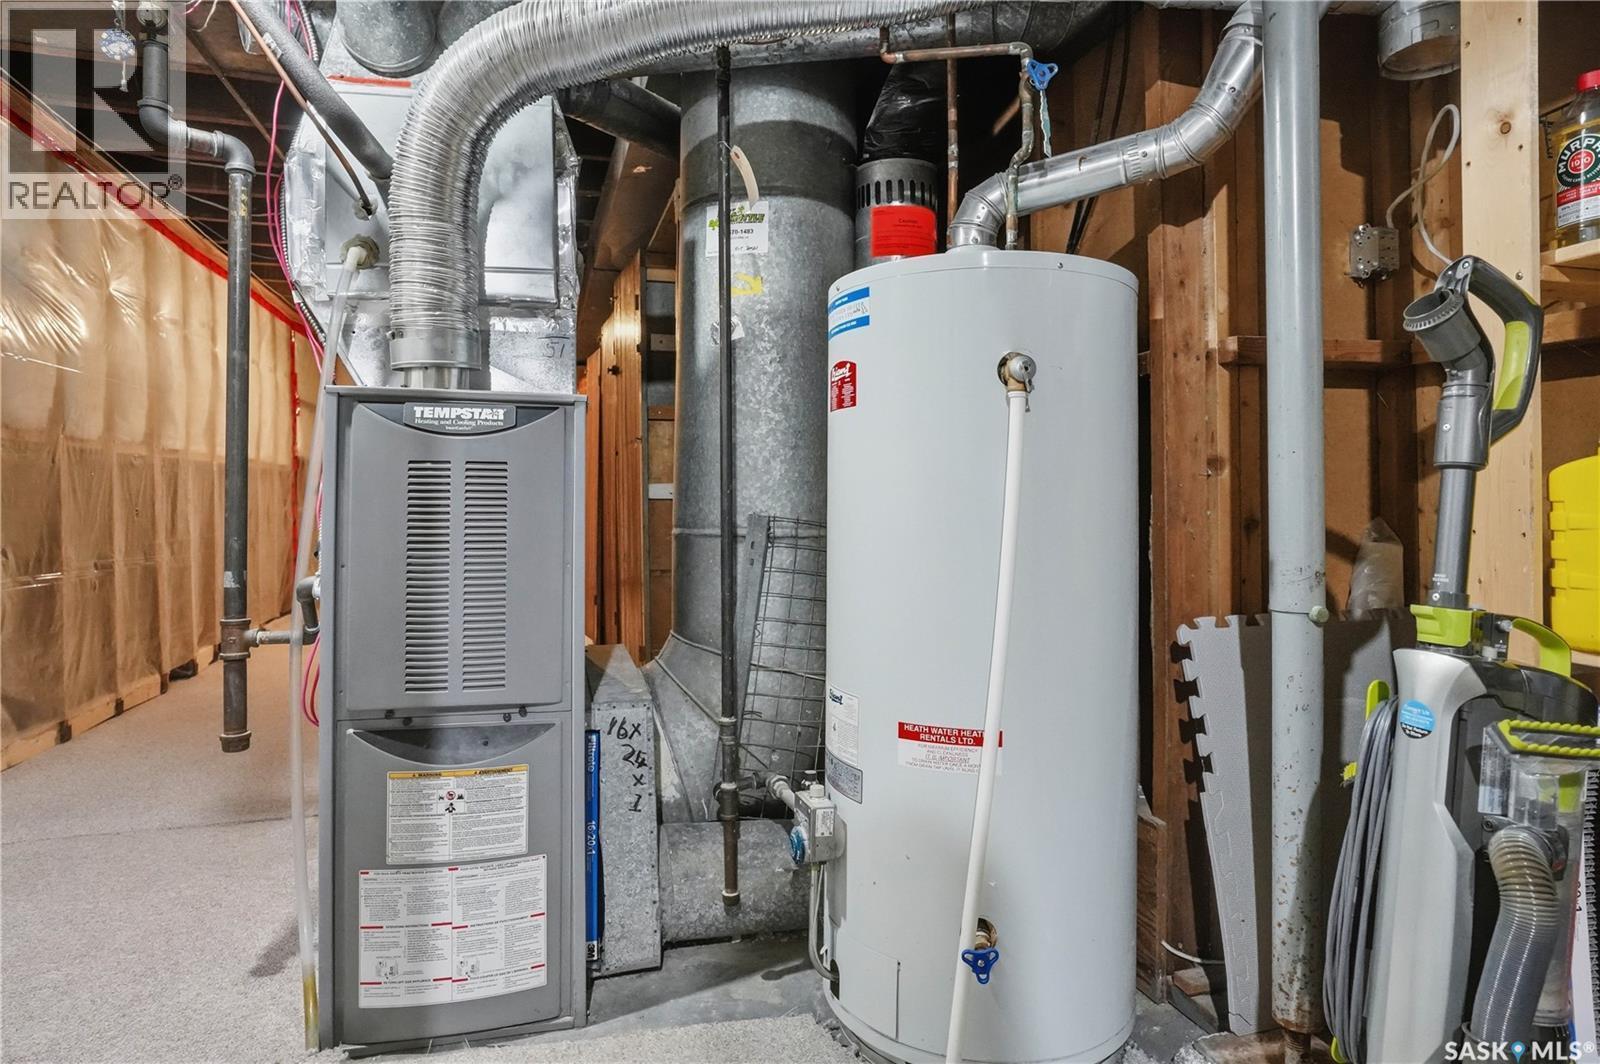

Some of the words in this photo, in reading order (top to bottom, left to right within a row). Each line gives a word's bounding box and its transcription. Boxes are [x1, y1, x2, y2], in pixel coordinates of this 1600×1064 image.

[413, 406, 504, 420] TEMPSTAR
[414, 418, 439, 426] Heating
[453, 419, 476, 427] Cooling
[904, 724, 929, 734] HEATH
[930, 727, 960, 736] WATER
[960, 730, 985, 738] HEAT
[920, 733, 957, 744] RENTALS
[958, 737, 976, 745] LTD.
[587, 942, 596, 959] 3M
